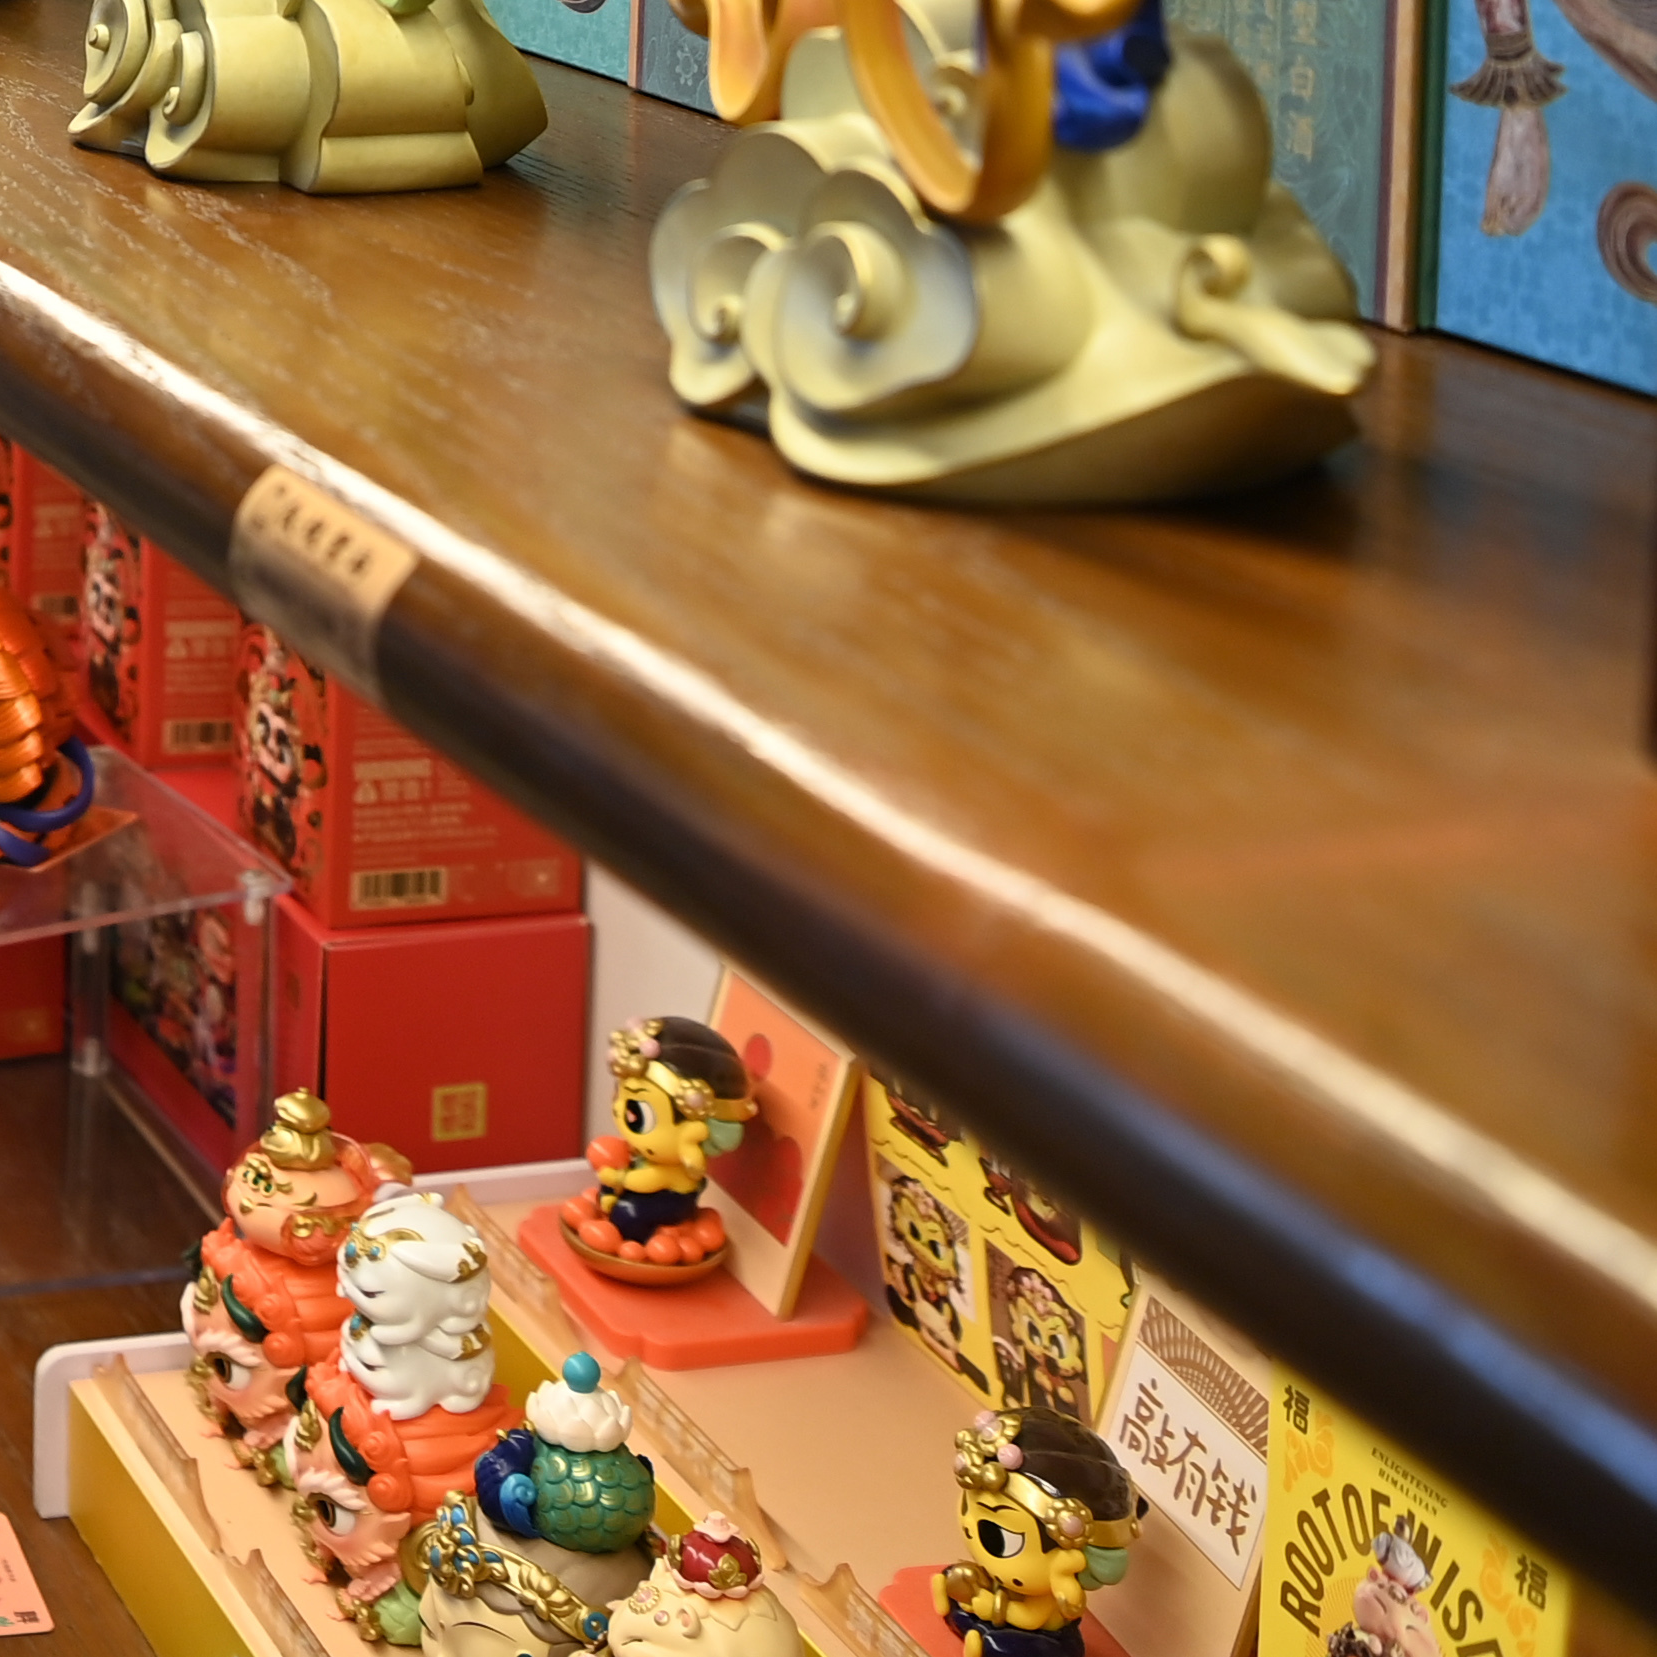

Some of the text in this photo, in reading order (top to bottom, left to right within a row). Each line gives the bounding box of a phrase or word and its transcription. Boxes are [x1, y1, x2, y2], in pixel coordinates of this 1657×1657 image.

[1282, 1383, 1311, 1436] 福
[1118, 1377, 1258, 1557] 敲有钱
[1370, 1446, 1451, 1510] ENLIGHTENING
[1377, 1467, 1439, 1518] HIMALAYAN
[1279, 1487, 1348, 1639] ROOT
[1341, 1482, 1392, 1559] OF
[1514, 1553, 1549, 1613] 福
